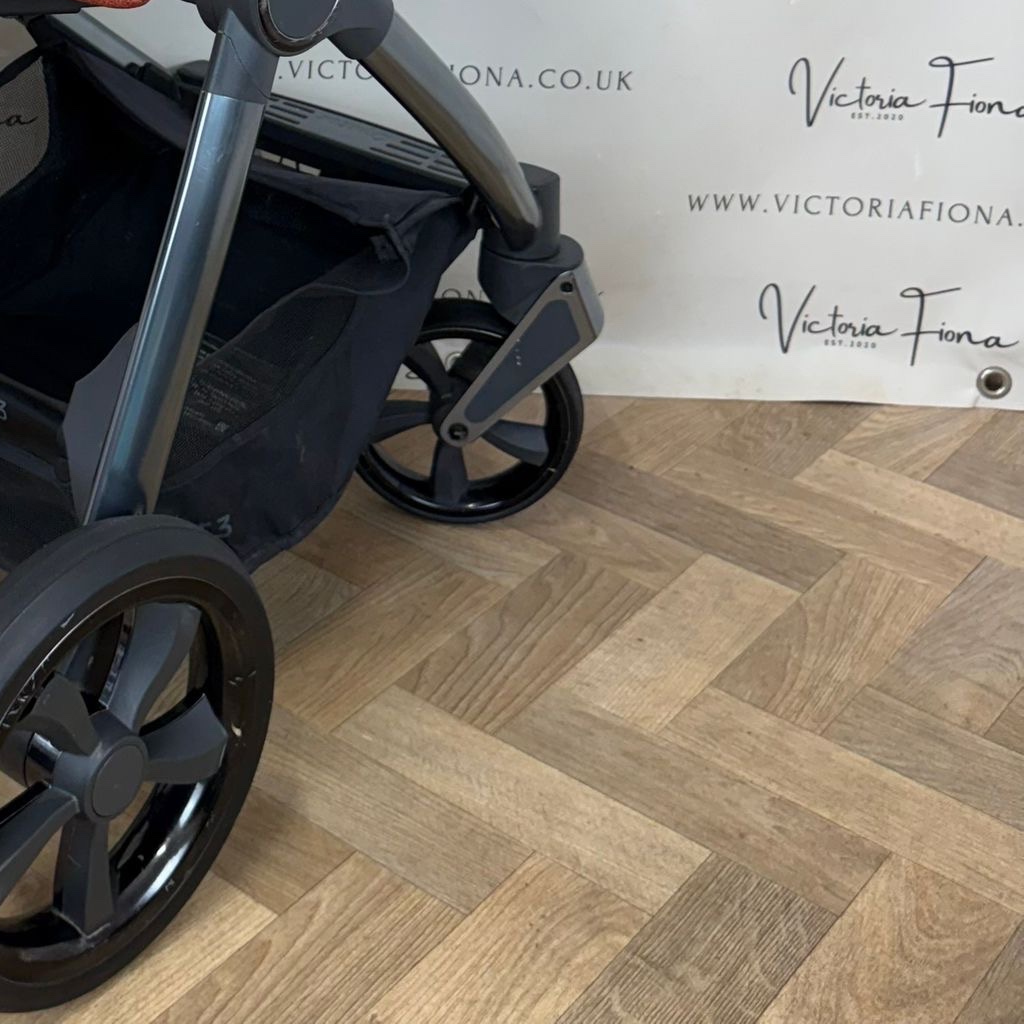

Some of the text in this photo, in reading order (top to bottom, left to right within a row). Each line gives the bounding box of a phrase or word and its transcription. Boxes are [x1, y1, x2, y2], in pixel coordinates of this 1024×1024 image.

[788, 56, 926, 127] Victoria
[851, 112, 904, 121] EST.2020
[759, 283, 1019, 366] Victoria Fiona
[824, 339, 877, 349] EST.2020
